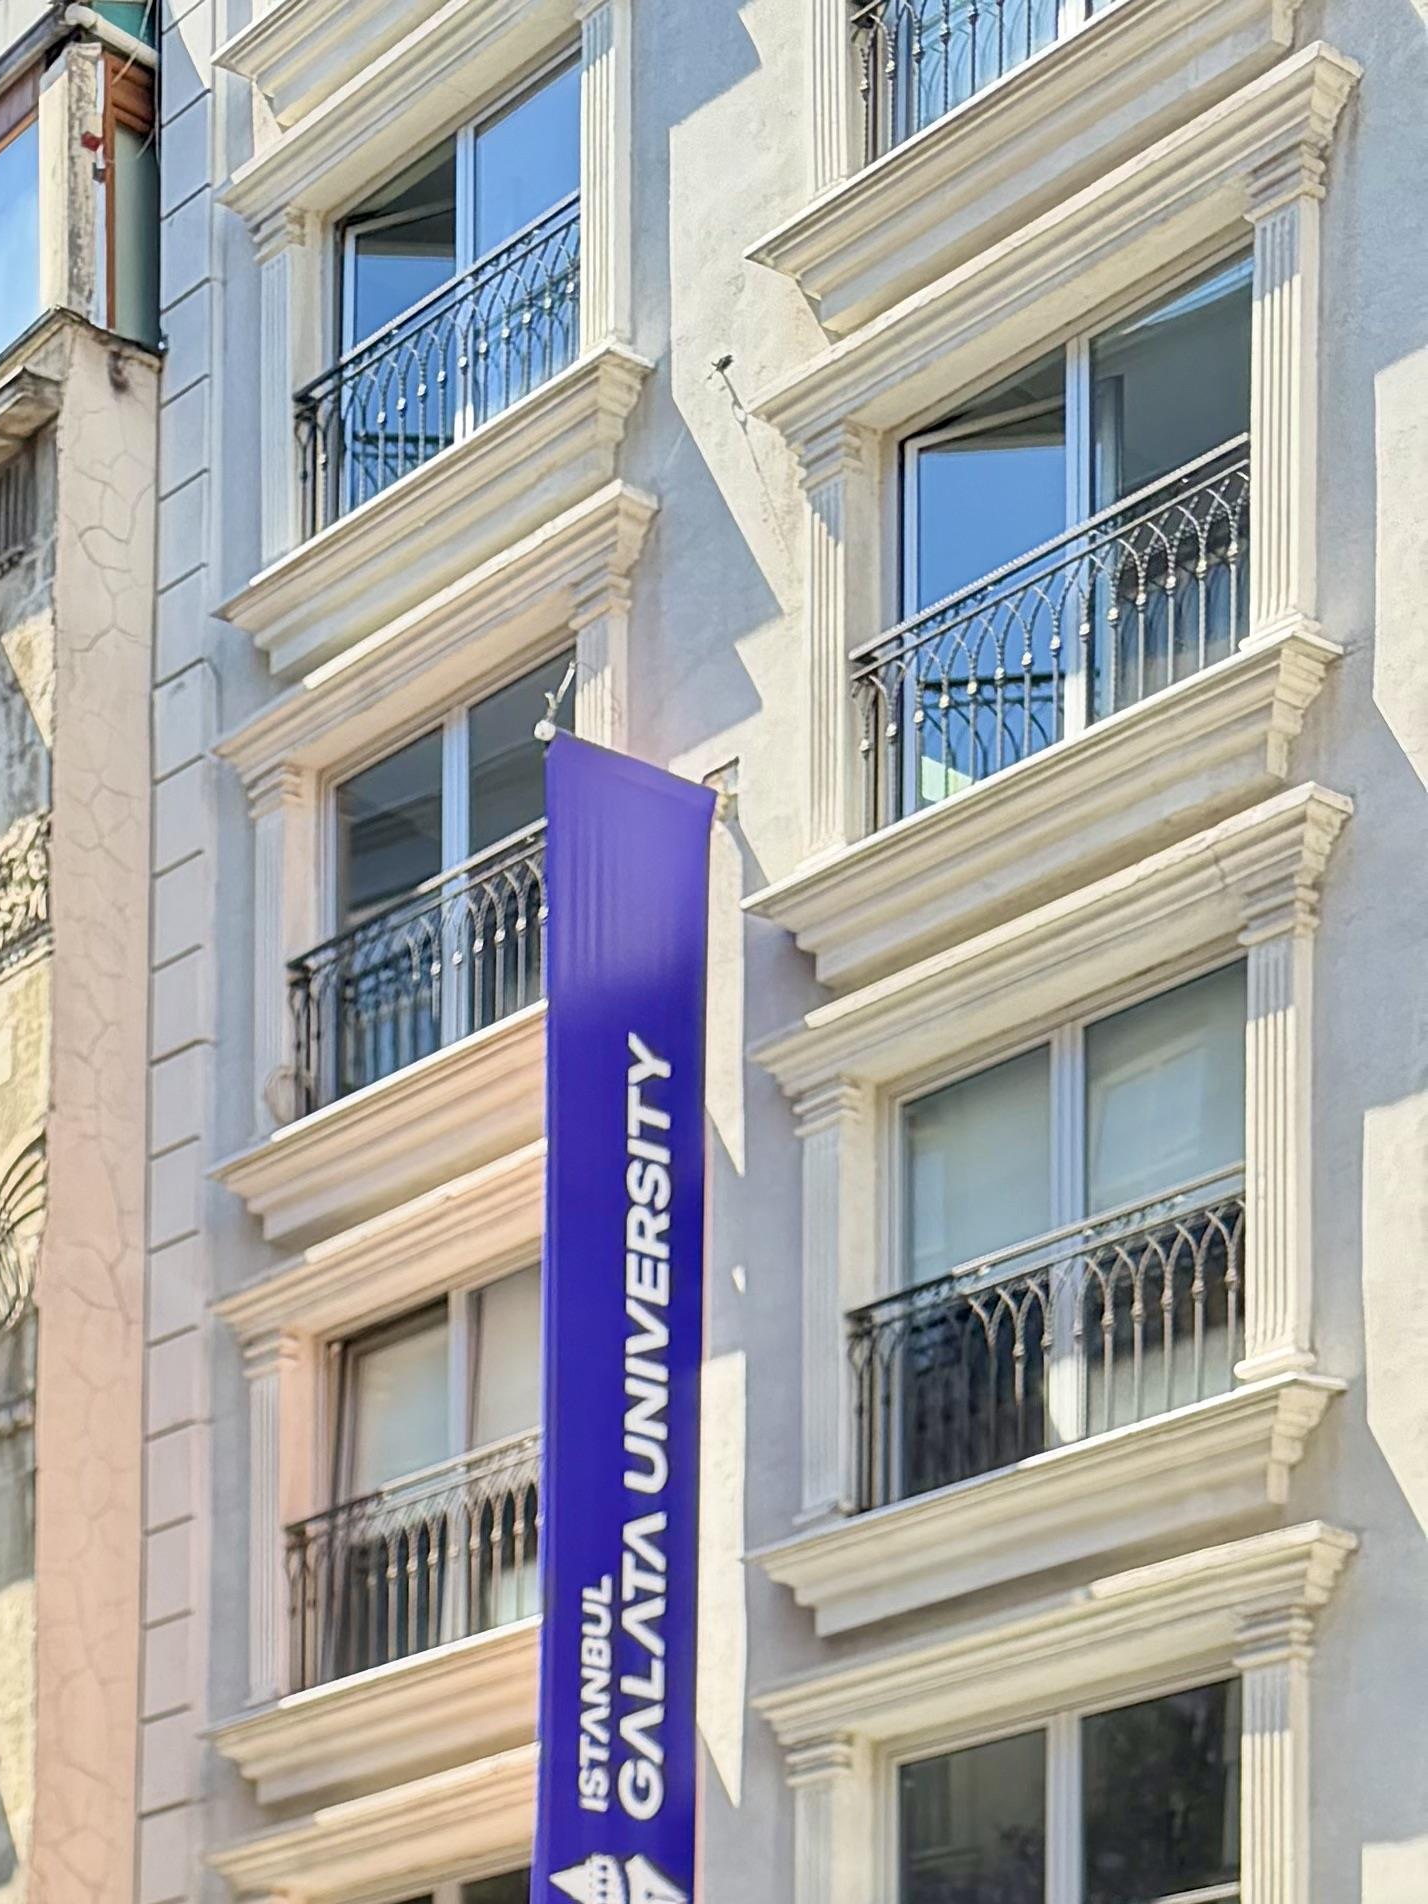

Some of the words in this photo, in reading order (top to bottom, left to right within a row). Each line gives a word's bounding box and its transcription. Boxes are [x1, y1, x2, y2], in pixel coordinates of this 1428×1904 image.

[623, 1031, 672, 1494] UNIVERSITY
[578, 1574, 612, 1812] ISTANBUL
[618, 1511, 668, 1820] GALATA
